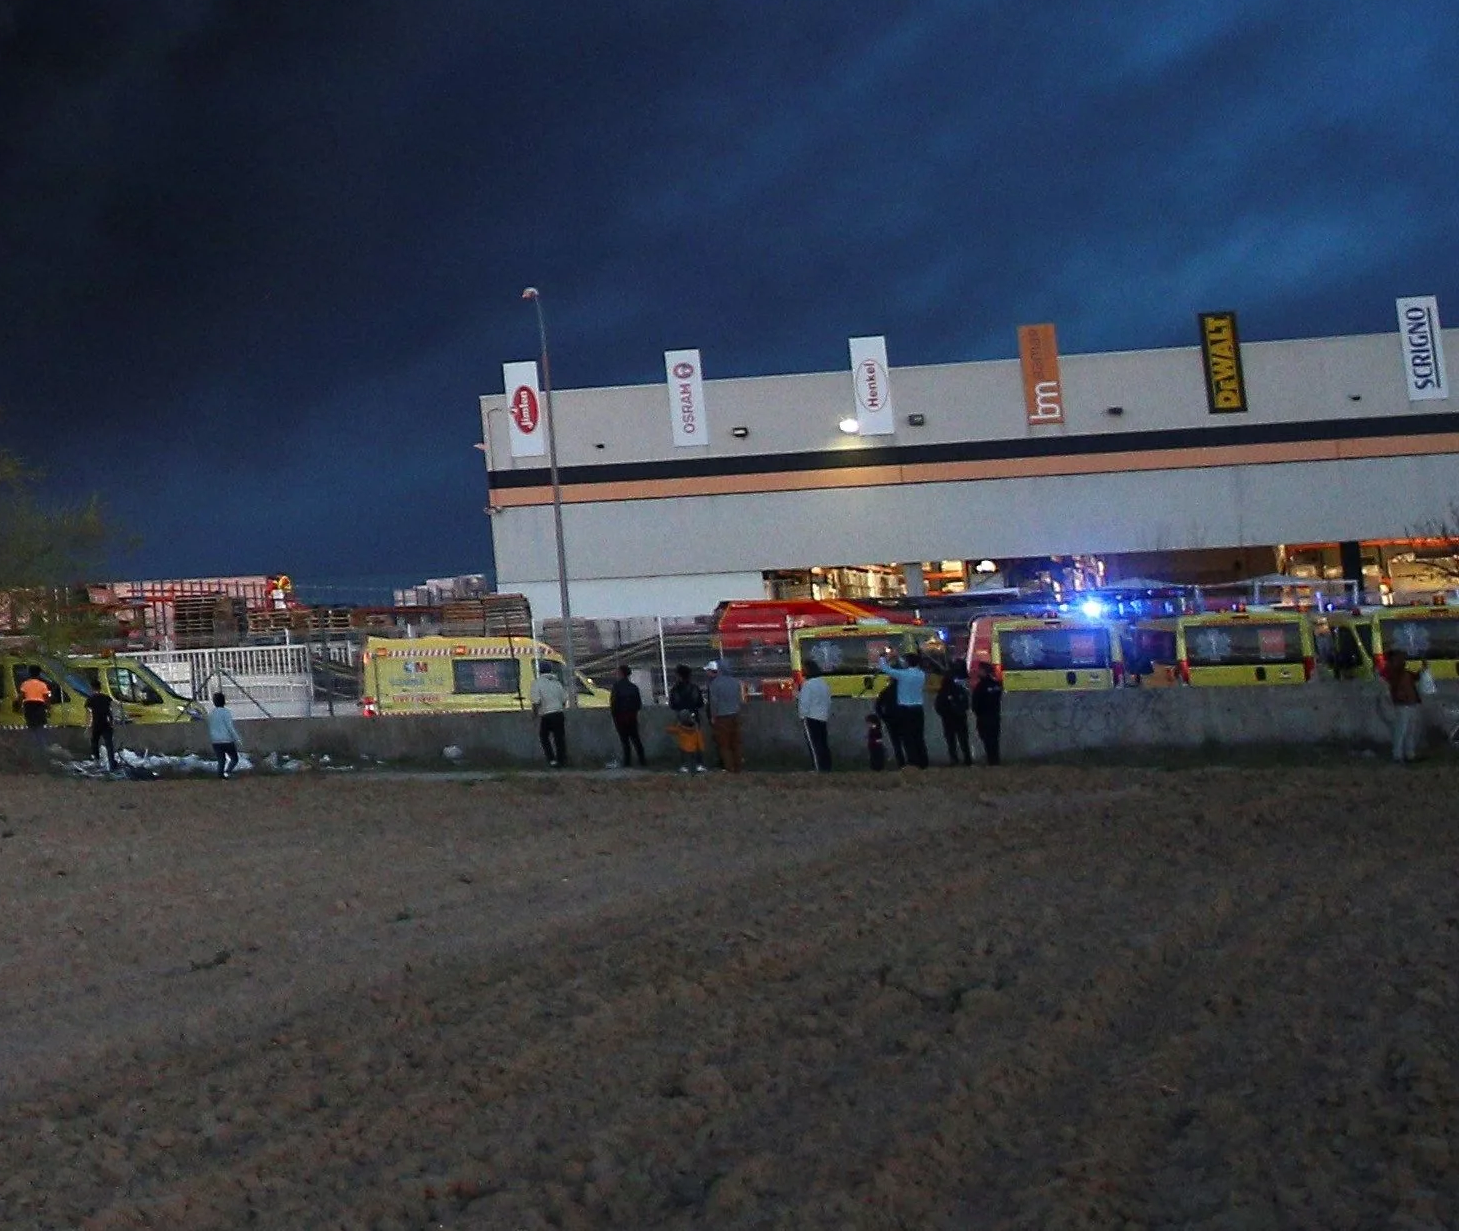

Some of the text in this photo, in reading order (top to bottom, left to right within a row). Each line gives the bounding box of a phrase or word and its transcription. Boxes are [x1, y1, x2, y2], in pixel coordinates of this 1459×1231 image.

[1407, 306, 1435, 390] SCRIGNO
[680, 382, 696, 433] OSRAM
[863, 361, 880, 408] Henkel
